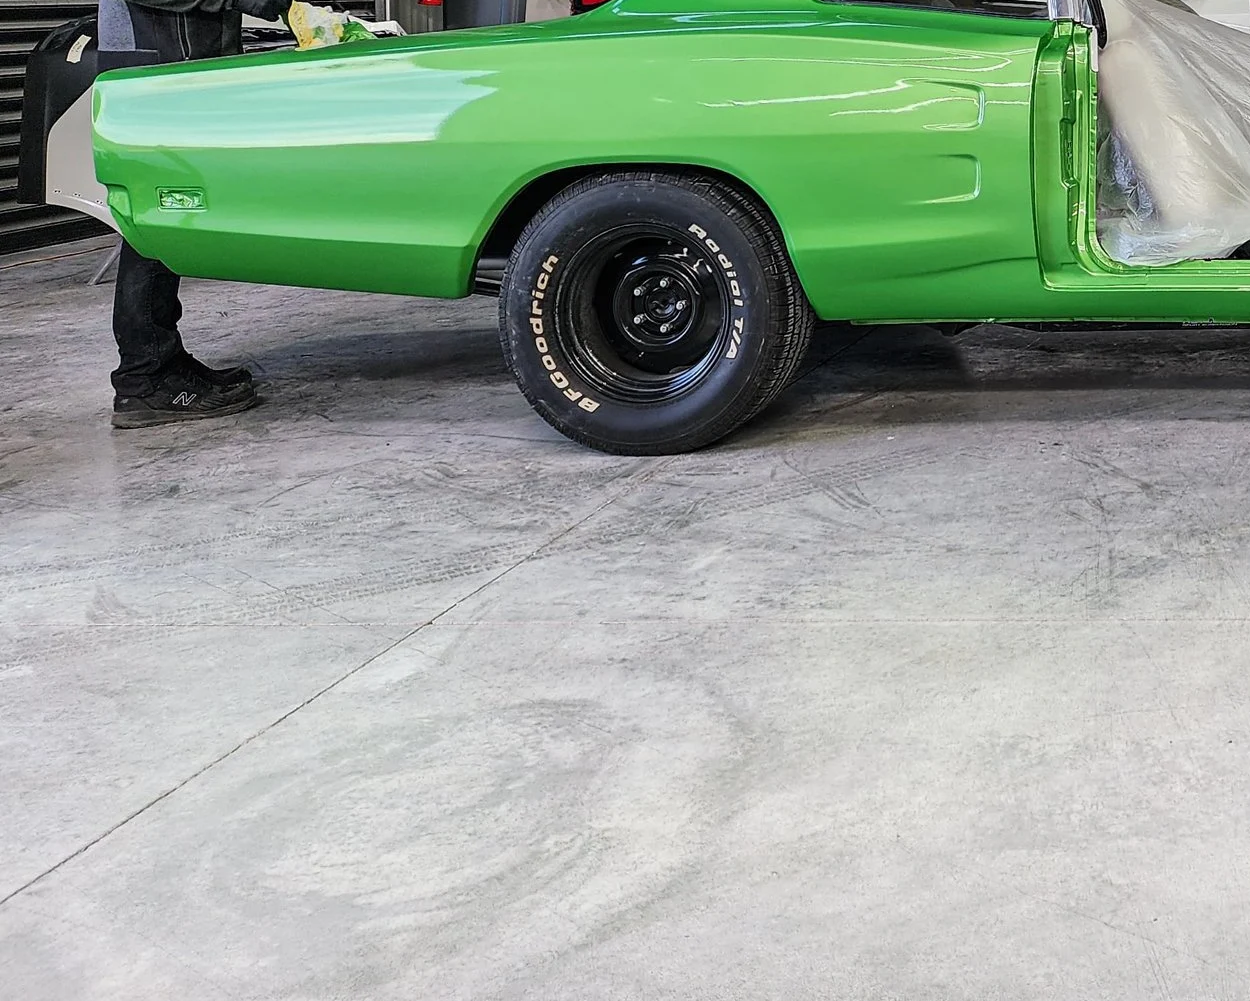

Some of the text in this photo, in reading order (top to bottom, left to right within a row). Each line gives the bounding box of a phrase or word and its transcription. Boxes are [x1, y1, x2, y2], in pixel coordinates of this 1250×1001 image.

[529, 255, 600, 413] BFGoodrich
[689, 223, 745, 359] Radial T/A
